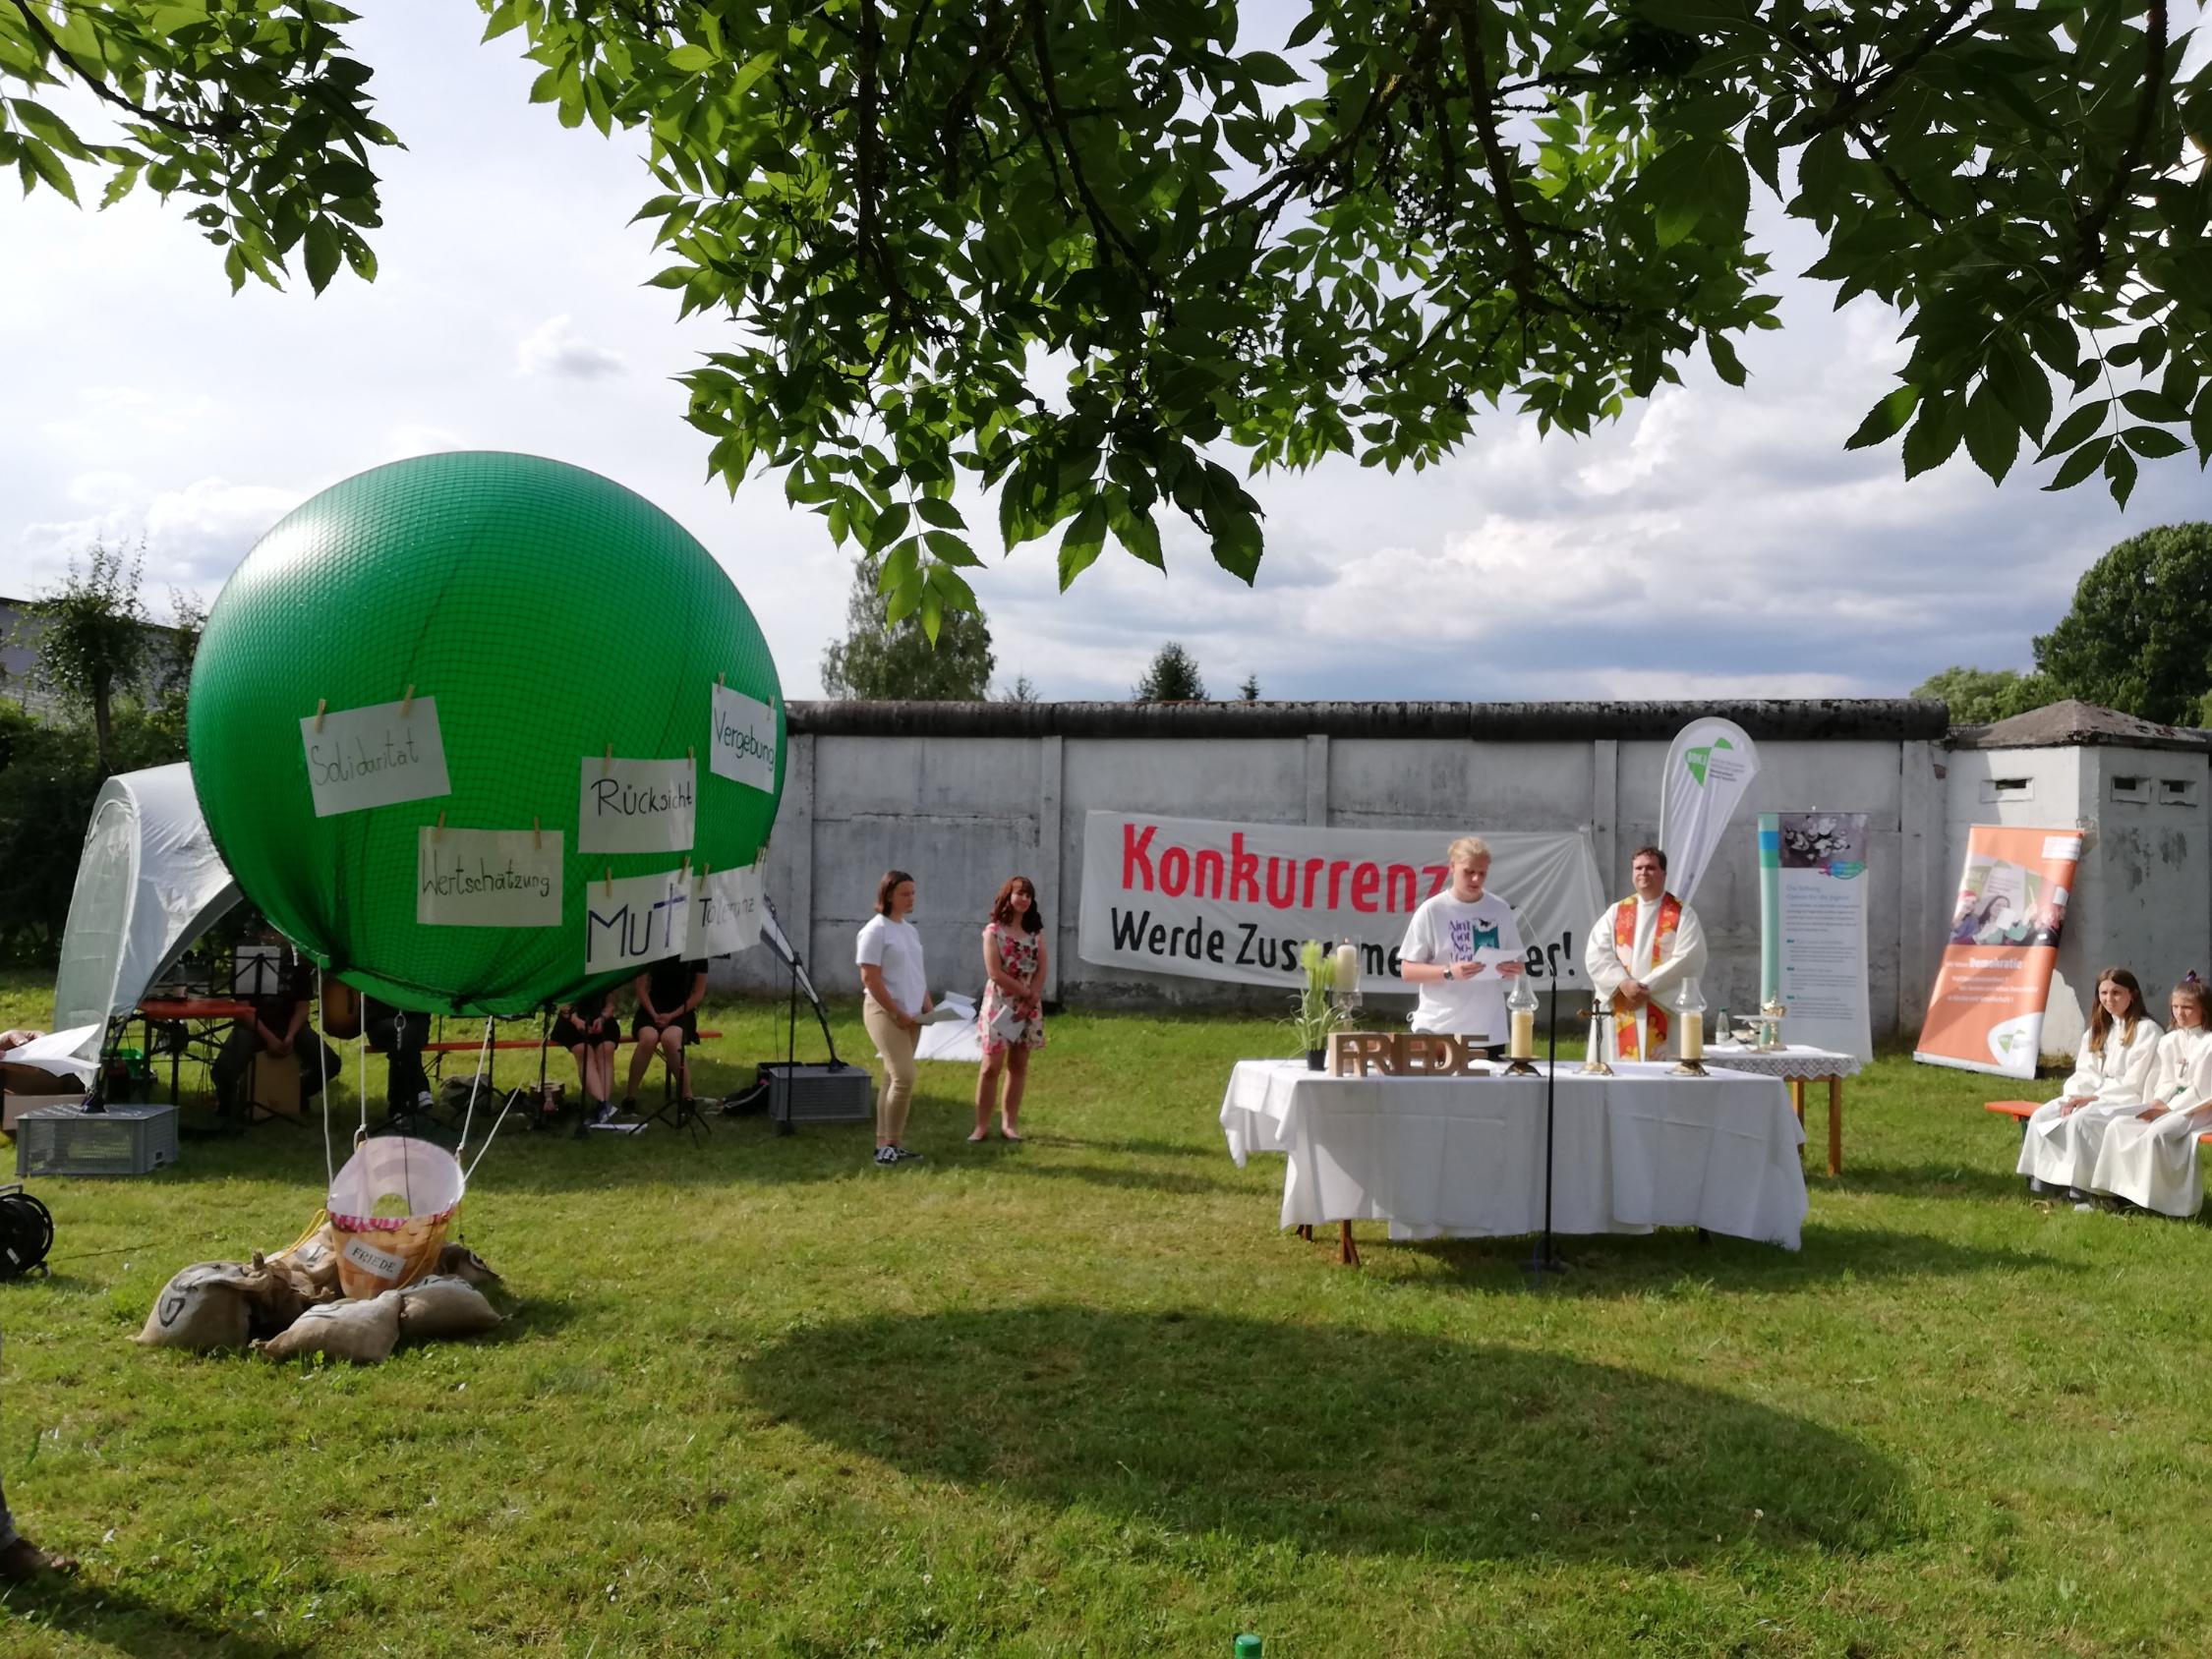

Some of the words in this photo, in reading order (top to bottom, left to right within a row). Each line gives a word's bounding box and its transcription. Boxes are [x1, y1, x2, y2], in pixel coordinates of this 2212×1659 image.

[714, 708, 775, 772] Vergebung
[590, 778, 692, 816] Rücksicht
[422, 849, 550, 896] Wertschätzung
[1111, 907, 1224, 964] Werde
[1329, 1032, 1490, 1077] FRIEDE
[351, 1246, 396, 1274] FRIEDE
